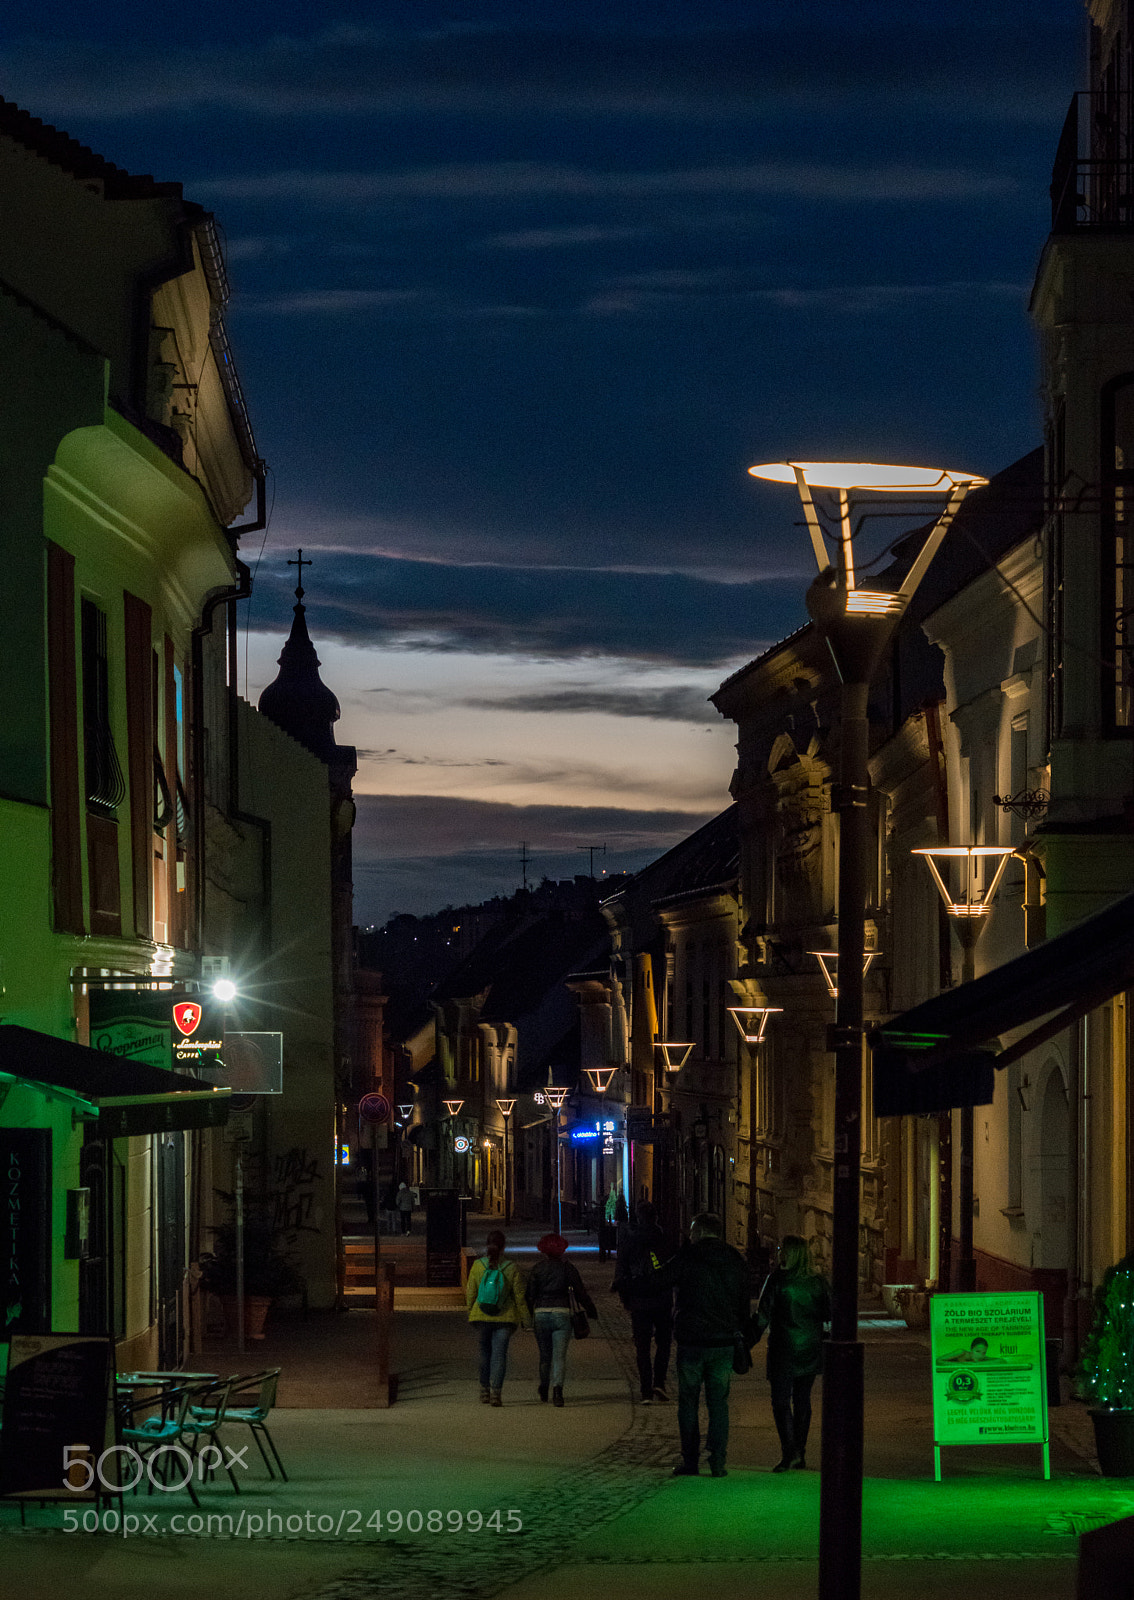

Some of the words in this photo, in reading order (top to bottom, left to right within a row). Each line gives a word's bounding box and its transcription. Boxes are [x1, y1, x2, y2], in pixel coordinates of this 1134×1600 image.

[176, 1038, 222, 1050] Lamborghini
[8, 1152, 21, 1286] KOZMETIKA
[984, 1308, 1031, 1316] SZOLÁRIUM
[956, 1377, 972, 1386] 0,3
